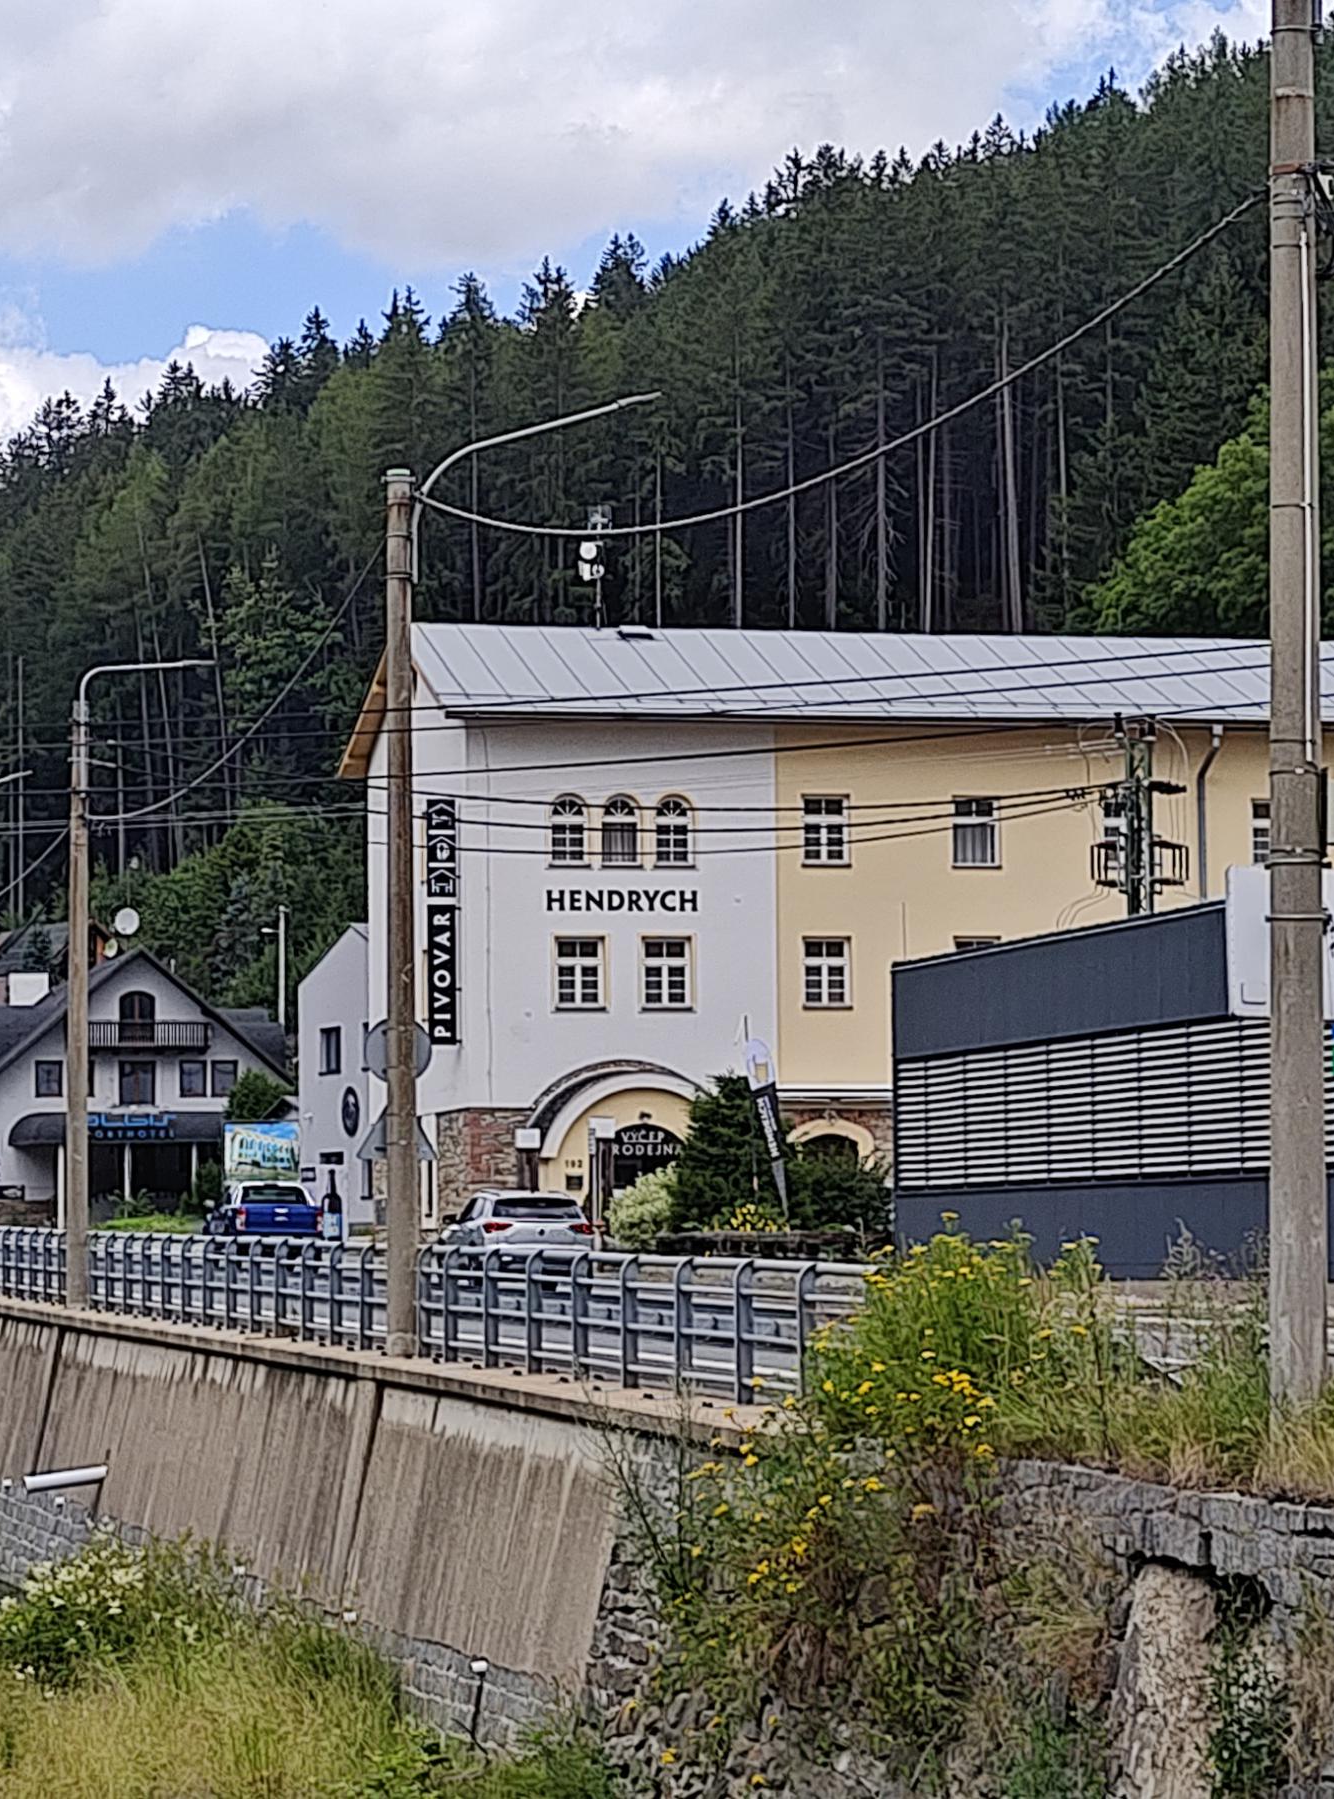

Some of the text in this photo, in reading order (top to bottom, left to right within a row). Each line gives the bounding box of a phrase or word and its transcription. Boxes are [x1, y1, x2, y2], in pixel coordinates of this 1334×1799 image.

[546, 889, 698, 912] HENDRYCH
[433, 912, 452, 1038] PIVOVAR
[620, 1128, 666, 1141] VÝČEP
[612, 1143, 684, 1156] RODEJNA
